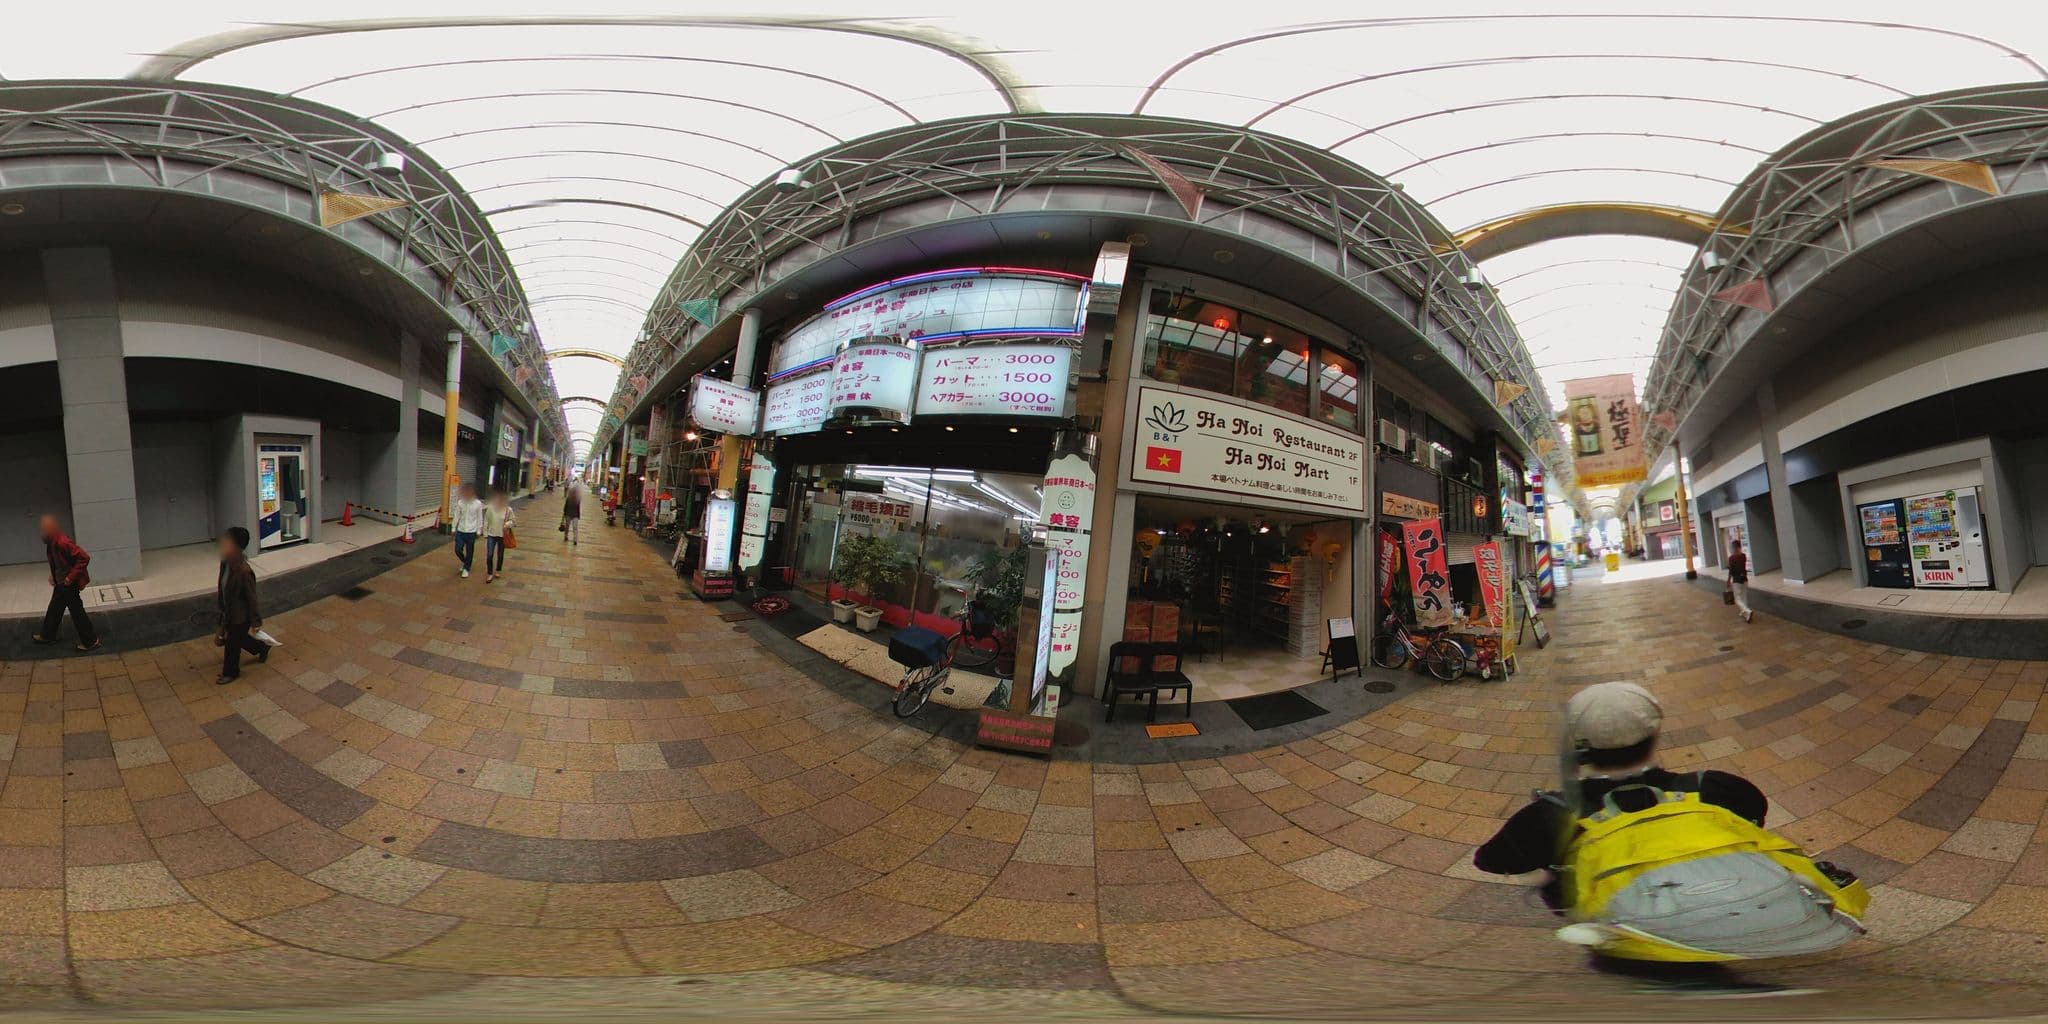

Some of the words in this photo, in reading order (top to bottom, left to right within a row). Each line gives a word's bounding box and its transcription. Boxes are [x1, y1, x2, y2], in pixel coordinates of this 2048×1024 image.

[1005, 354, 1056, 365] 3000
[801, 378, 825, 391] 3000
[932, 374, 975, 385] カット
[1003, 372, 1052, 384] 1500
[800, 392, 823, 404] 1500
[930, 392, 974, 402] ヘアカラー
[1196, 410, 1226, 430] Ha
[1232, 418, 1263, 438] Noi
[1273, 428, 1346, 459] Restaurant
[1348, 451, 1358, 462] 2F
[1225, 446, 1253, 466] Ha
[1257, 453, 1287, 472] Noi
[1294, 461, 1329, 481] Mart
[1348, 476, 1359, 485] 1F
[851, 499, 912, 518] 縮毛矯正
[1049, 512, 1080, 528] 美容
[1924, 571, 1955, 582] KIRIN
